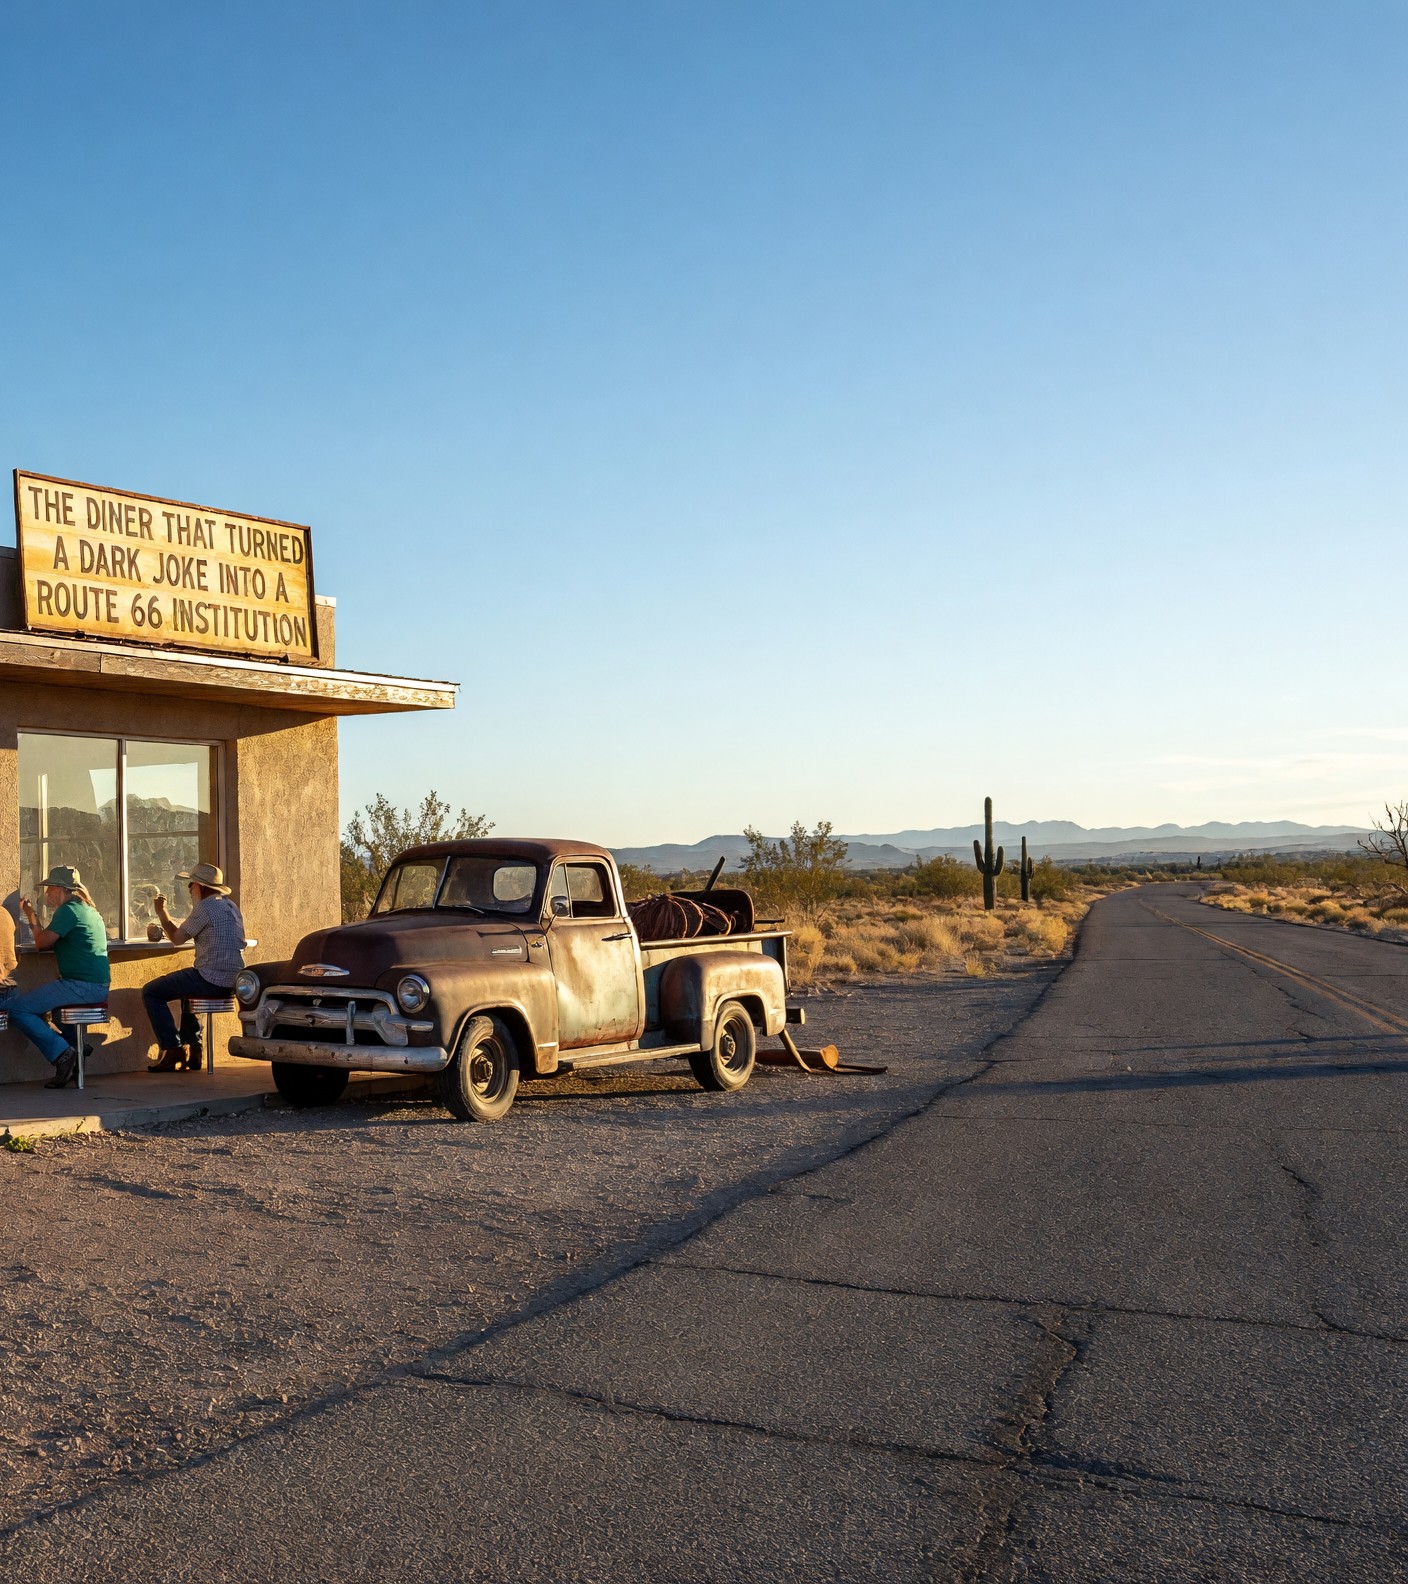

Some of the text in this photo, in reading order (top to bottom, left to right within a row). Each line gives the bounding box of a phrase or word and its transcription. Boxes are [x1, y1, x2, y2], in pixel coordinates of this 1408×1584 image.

[28, 486, 303, 564] THE DINER THAT TURNED
[53, 535, 289, 603] A DARK JOKE INTO A
[36, 579, 307, 647] ROUTE 66 INSTITUTION
